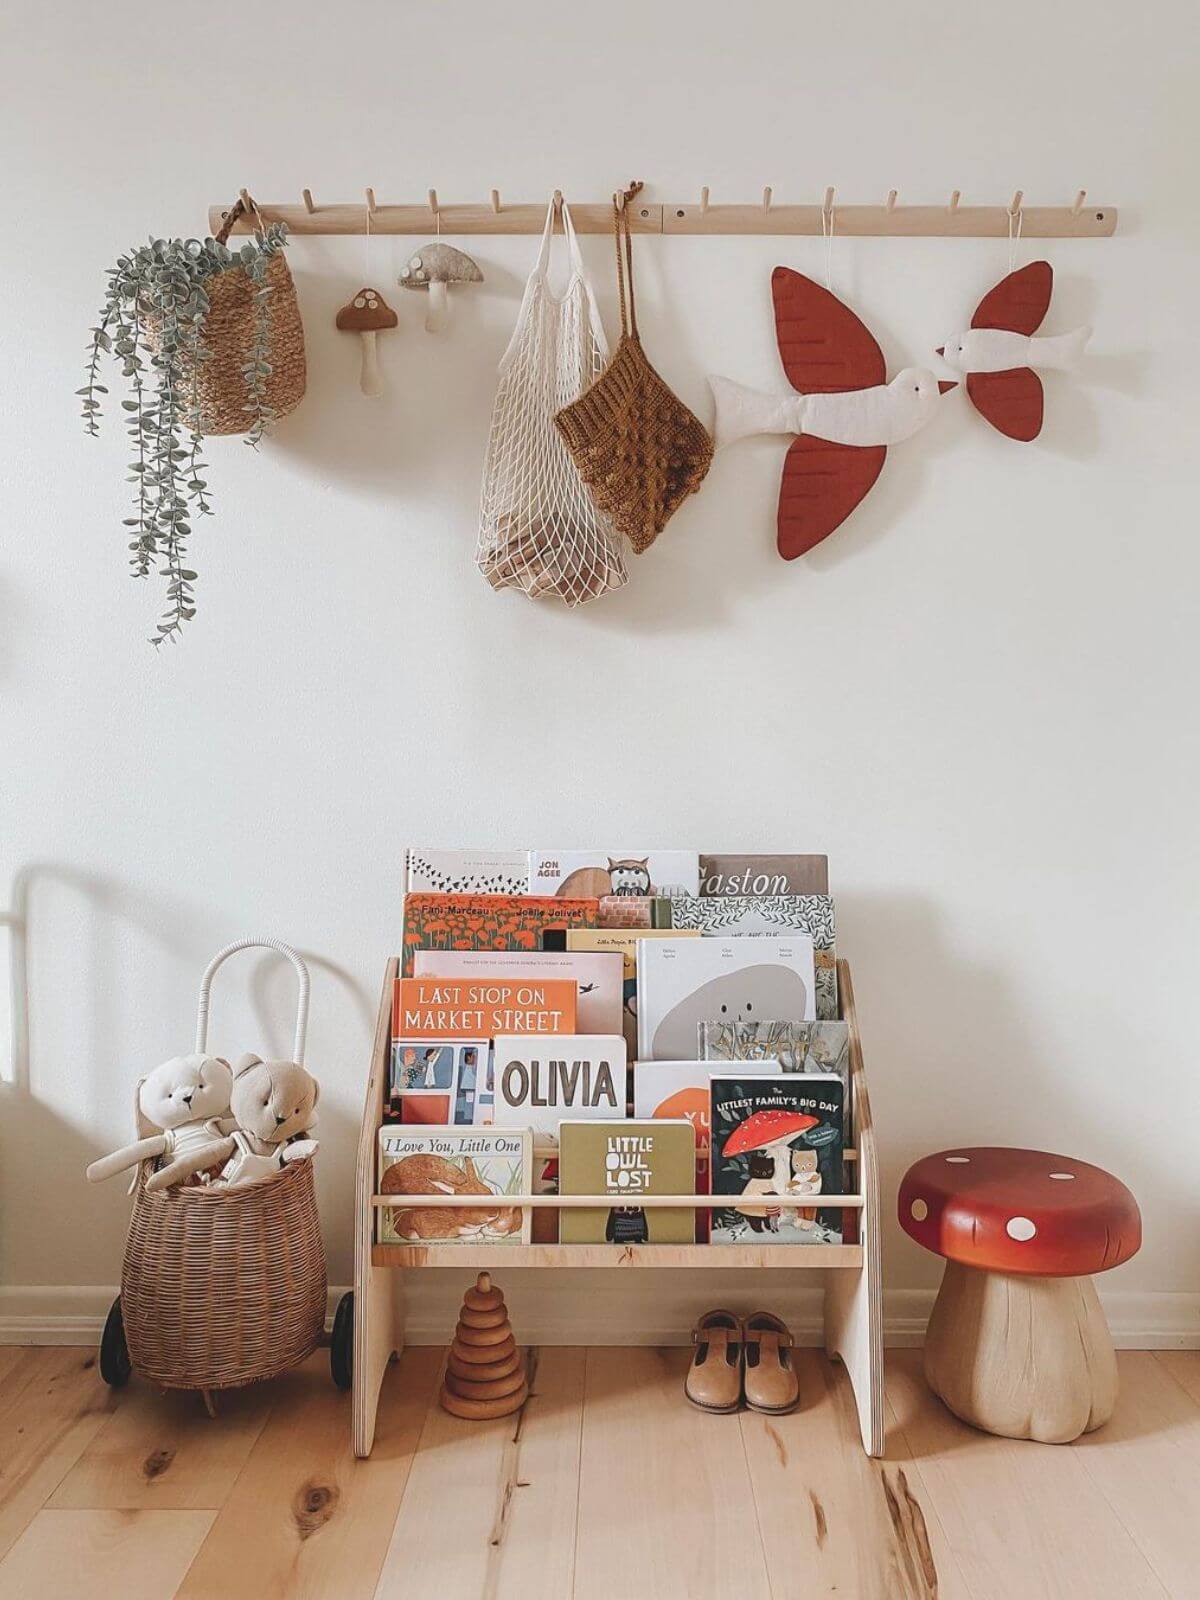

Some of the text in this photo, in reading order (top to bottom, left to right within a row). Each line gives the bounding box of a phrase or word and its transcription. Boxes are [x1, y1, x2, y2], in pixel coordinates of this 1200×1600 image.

[539, 861, 559, 869] JON
[537, 869, 561, 878] AGEE
[421, 904, 490, 916] Fani Marceau
[548, 908, 583, 918] Jolivet
[418, 986, 545, 1006] LAST STOP ON
[404, 1010, 562, 1032] MARKET STREET
[501, 1060, 618, 1107] OLIVIA
[716, 1096, 840, 1113] LITTLEST FAMILY'S BIG DAY
[385, 1138, 521, 1154] I Love You, Little One
[607, 1137, 653, 1152] LITTLE
[605, 1152, 648, 1170] OWL
[606, 1170, 653, 1187] LOST
